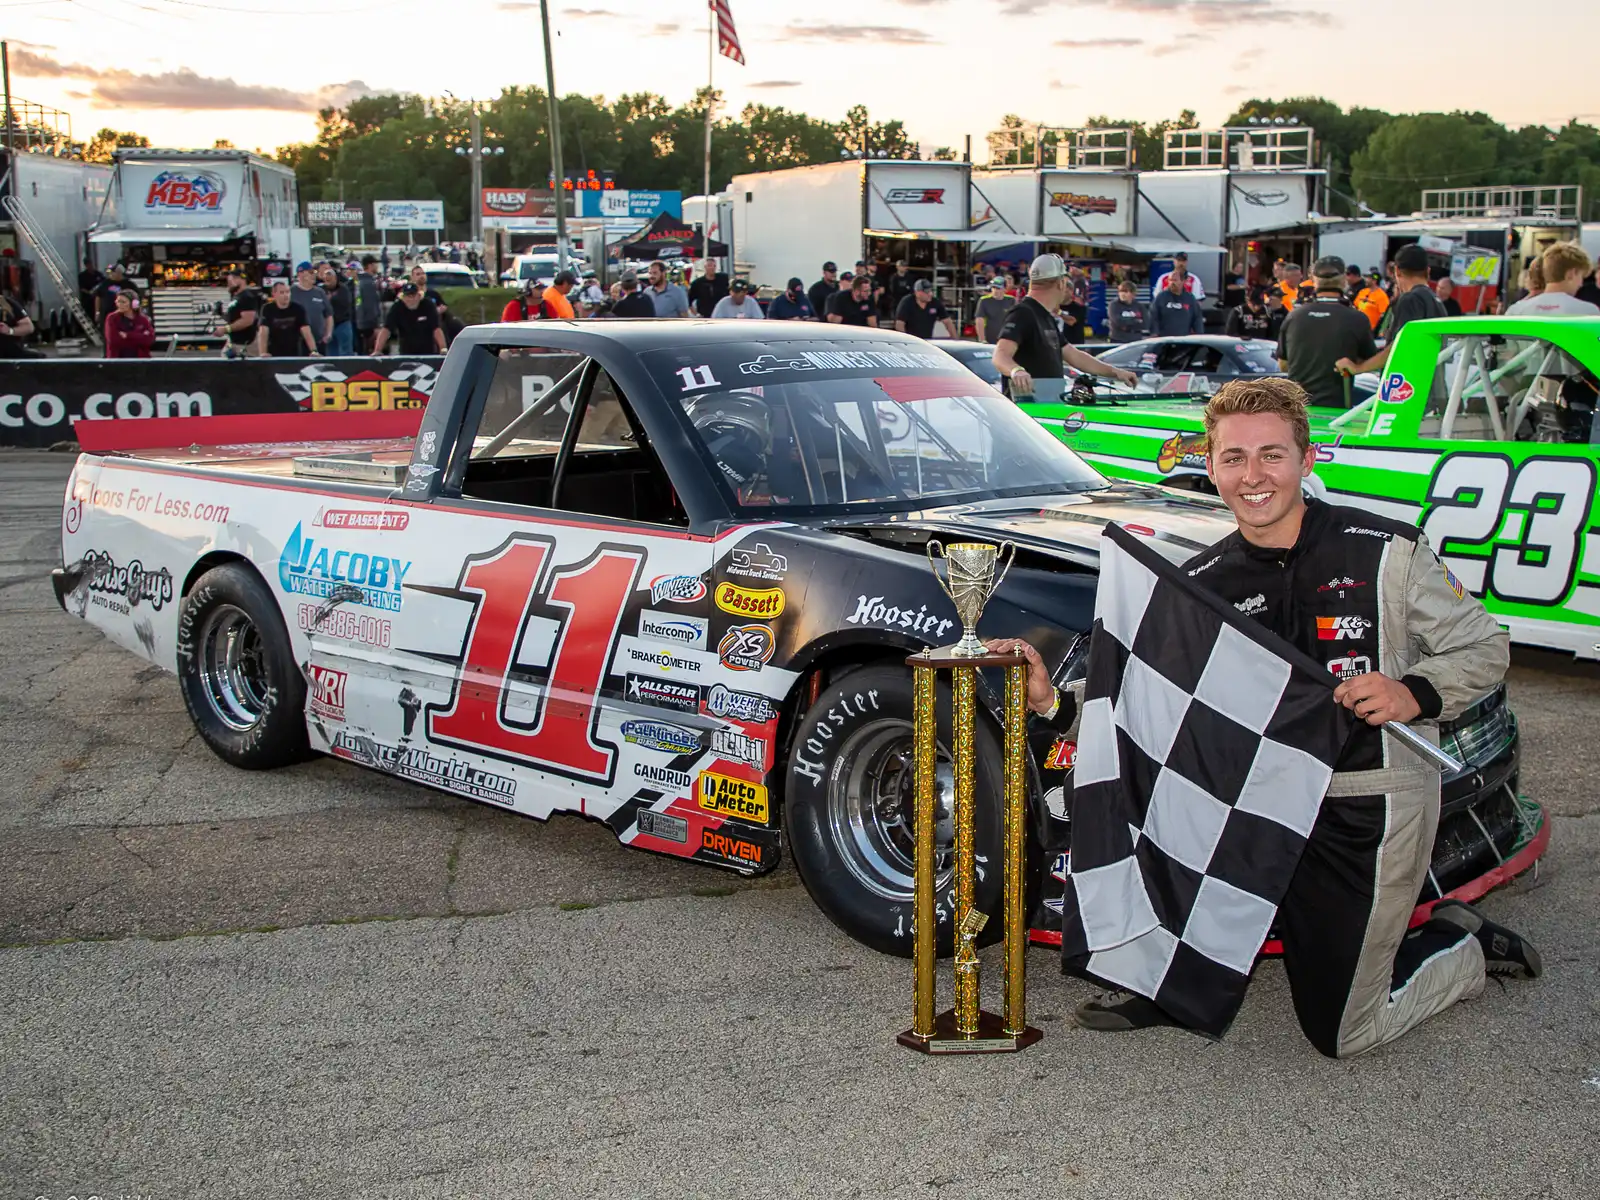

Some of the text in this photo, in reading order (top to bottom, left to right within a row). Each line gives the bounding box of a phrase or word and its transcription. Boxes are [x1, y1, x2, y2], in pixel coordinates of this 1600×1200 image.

[145, 179, 222, 211] KBM
[307, 202, 345, 211] MIDWEST
[486, 192, 526, 203] HAEN
[608, 197, 628, 210] Lite
[884, 188, 945, 204] GSR
[307, 211, 363, 221] RESTORATION
[648, 230, 695, 241] ALLIED
[675, 364, 722, 392] 11
[312, 381, 410, 411] BSF
[0, 391, 212, 427] co.com
[1371, 413, 1397, 435] E
[127, 488, 153, 513] For
[154, 491, 230, 523] Less.com
[325, 512, 347, 526] WET
[1420, 451, 1597, 606] 23
[289, 537, 412, 591] JACOBY
[92, 595, 130, 616] AUTO REPAIR
[723, 588, 779, 613] Bassett
[1338, 590, 1345, 599] 11
[846, 595, 953, 638] Hoosier
[642, 619, 695, 643] Intercomp
[722, 629, 765, 657] XS
[427, 533, 647, 787] 11
[631, 649, 701, 672] BRAKEOMETER
[728, 654, 761, 670] POWER
[310, 667, 346, 707] MRI
[640, 680, 698, 698] ALLSTAR
[640, 691, 697, 708] PERFORMANCE
[793, 688, 880, 788] Hoosier
[634, 763, 691, 787] GANDRUD
[644, 778, 669, 788] PERFORMANCE
[409, 769, 444, 785] GRAPHICS
[449, 780, 471, 794] SIGNS
[478, 788, 514, 806] BANNERS
[718, 778, 756, 800] Auto
[715, 793, 765, 816] Meter
[703, 831, 762, 863] DRIVEN
[728, 854, 760, 868] RACING OIL
